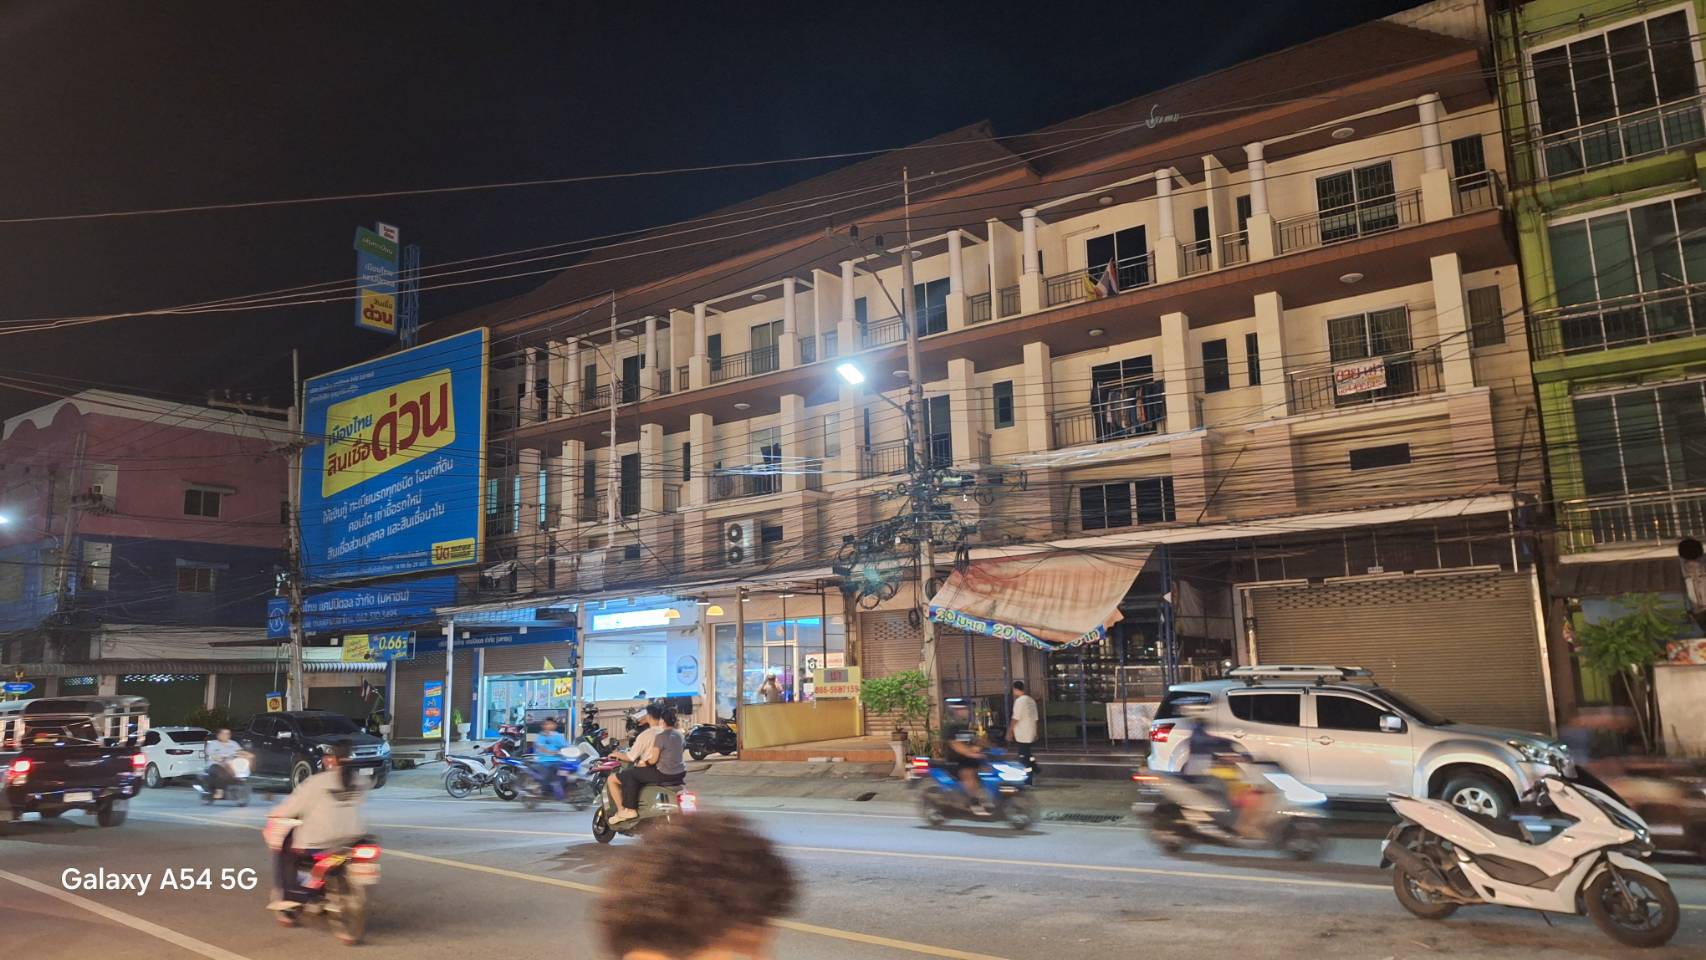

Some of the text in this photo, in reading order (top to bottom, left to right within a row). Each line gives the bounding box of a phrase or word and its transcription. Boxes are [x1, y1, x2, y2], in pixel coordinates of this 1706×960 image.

[362, 303, 393, 325] ด่วน
[328, 414, 373, 447] เมืองไทย
[371, 382, 448, 461] ด่วน
[327, 433, 371, 476] สินเชื่อ
[349, 475, 414, 511] ทะเบียนรถทุกชนิด
[416, 456, 454, 484] โฉนดที่ดิน
[327, 501, 446, 560] สินเชื่อส่วนบุคคล และสินเชื่อนาโน
[348, 511, 373, 532] คอนโด
[355, 593, 375, 607] จำกัด
[377, 589, 410, 605] (มหาชน)
[935, 607, 956, 623] 20
[957, 615, 987, 633] บาท
[992, 622, 1017, 640] 20
[379, 635, 402, 650] 0.66
